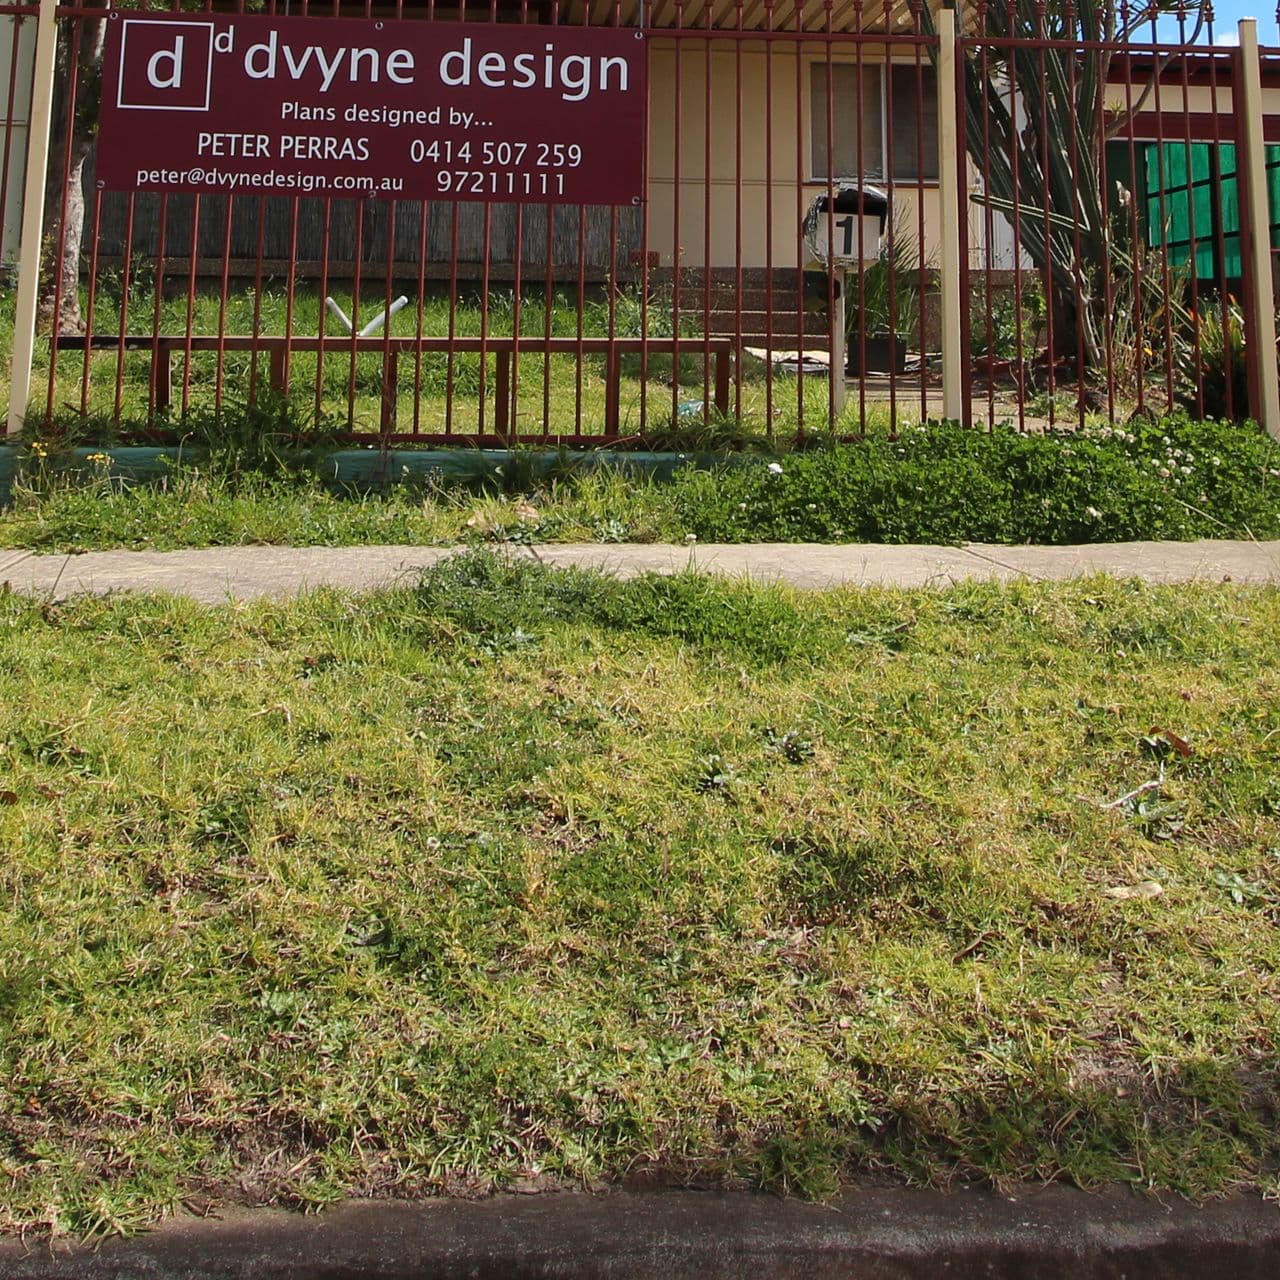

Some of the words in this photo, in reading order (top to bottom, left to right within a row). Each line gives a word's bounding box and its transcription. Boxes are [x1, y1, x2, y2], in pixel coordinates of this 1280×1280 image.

[146, 35, 184, 89] d
[214, 24, 235, 53] d
[244, 30, 415, 92] dvyne
[439, 37, 628, 102] design
[281, 101, 336, 121] Plans
[344, 103, 441, 128] designed
[449, 106, 493, 130] by...
[197, 132, 271, 158] PETER
[280, 135, 370, 161] PERRAS
[410, 139, 472, 164] 0414
[482, 141, 528, 166] 507
[536, 143, 582, 167] 259
[136, 167, 403, 192] peter@dvynedesign.com.au
[437, 170, 564, 195] 97211111
[836, 215, 853, 255] 1
